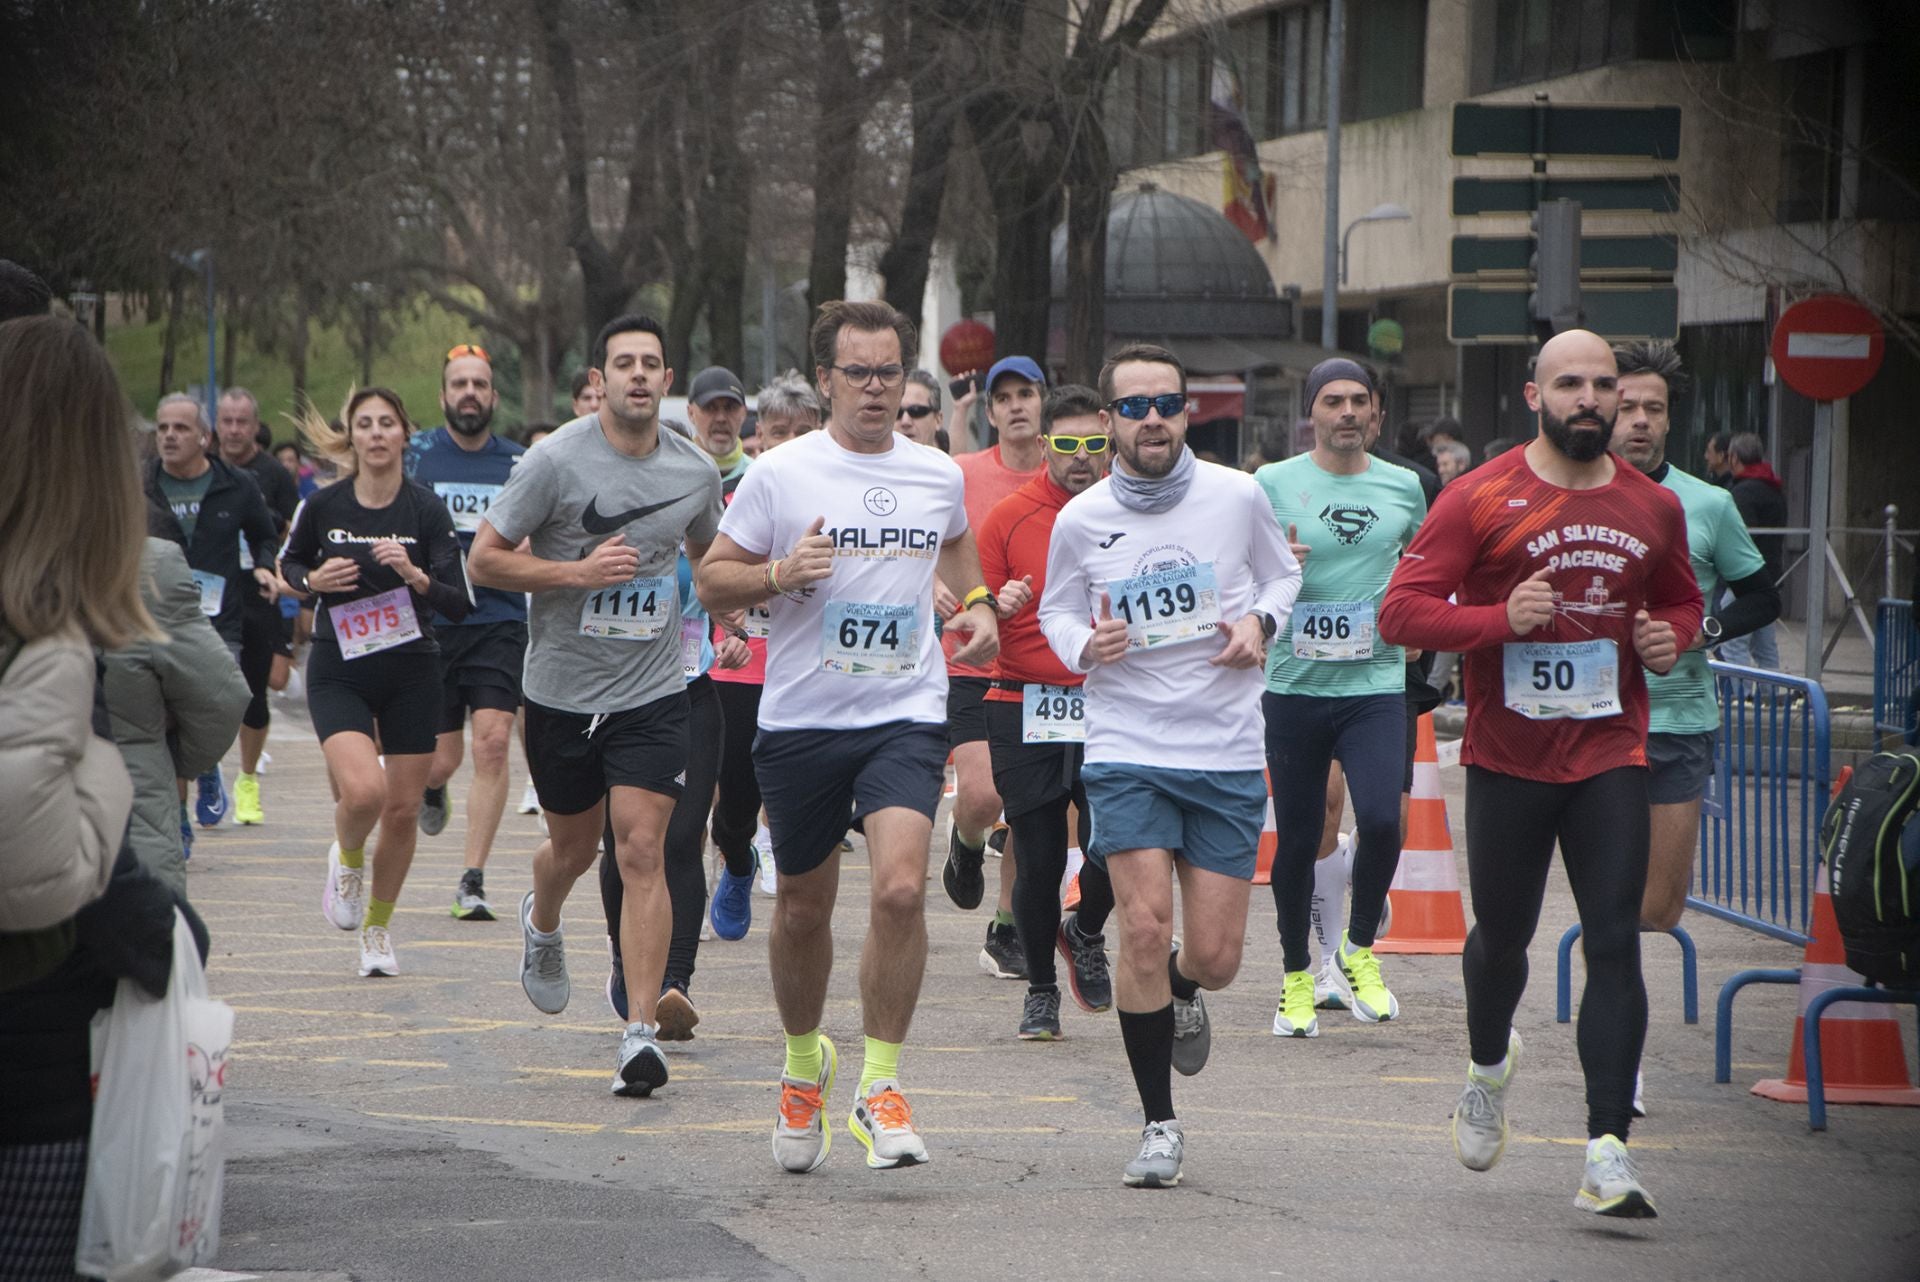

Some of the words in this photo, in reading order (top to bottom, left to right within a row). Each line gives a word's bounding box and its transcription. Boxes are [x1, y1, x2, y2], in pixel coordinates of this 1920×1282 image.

[1527, 529, 1560, 557] SAN
[1563, 524, 1649, 559] SILVESTRE
[1548, 550, 1628, 573] PACENSE
[591, 591, 656, 616] 1114
[1117, 583, 1196, 624] 1139
[339, 605, 399, 640] 1375
[839, 618, 899, 650] 674
[1303, 615, 1350, 640] 496
[1532, 660, 1574, 691] 50
[1035, 697, 1085, 721] 498
[1592, 700, 1613, 709] HOY
